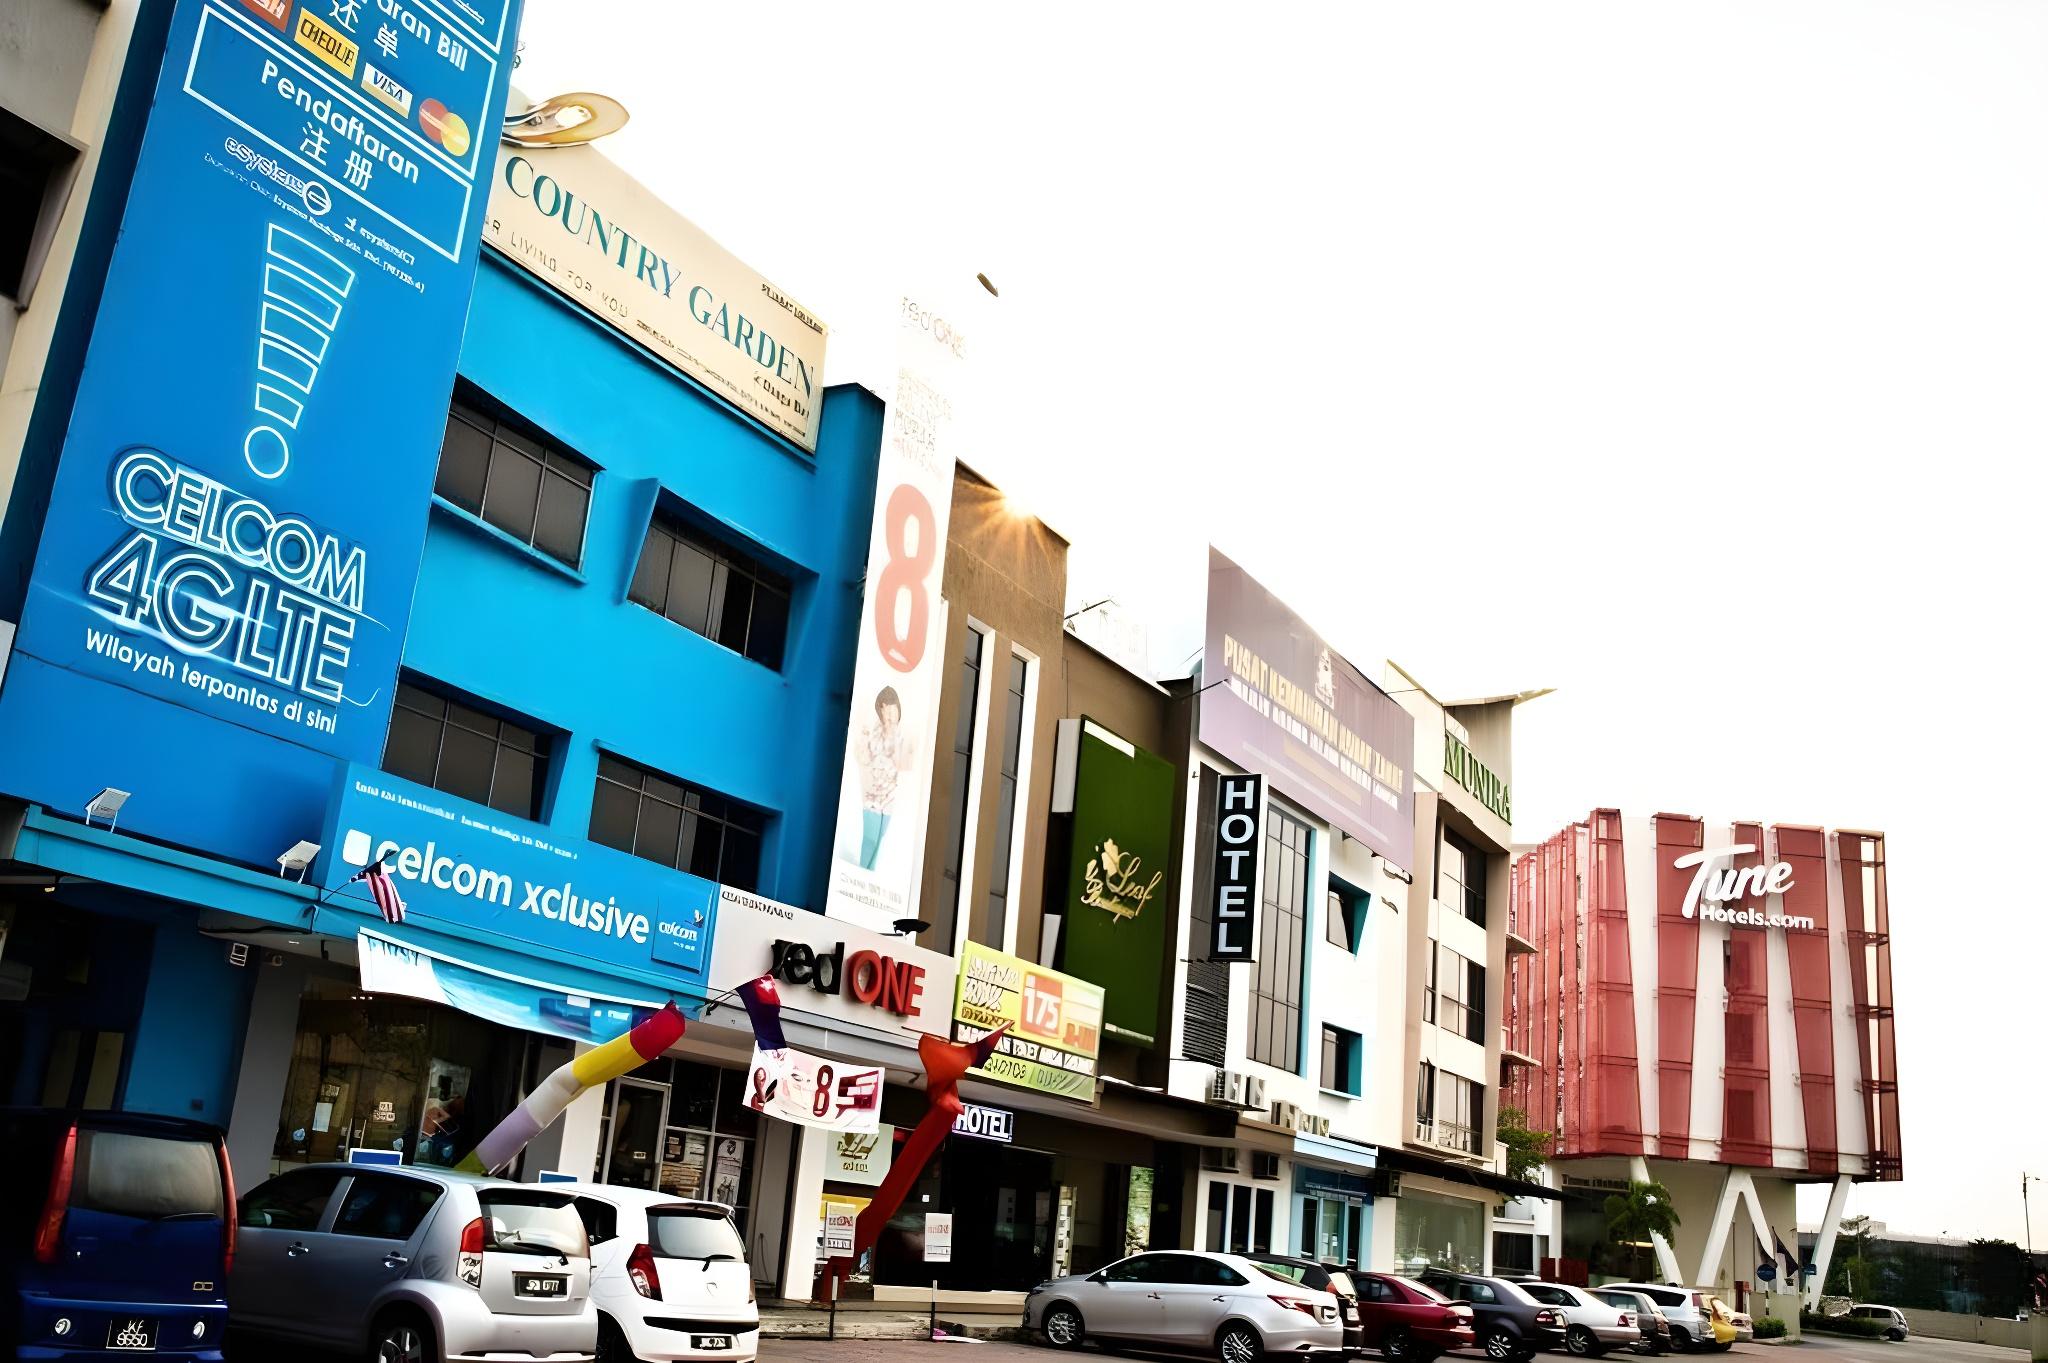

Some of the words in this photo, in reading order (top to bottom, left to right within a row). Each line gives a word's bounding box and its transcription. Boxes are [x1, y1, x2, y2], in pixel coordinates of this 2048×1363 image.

[362, 0, 430, 45] aran
[437, 31, 468, 72] Bill
[261, 59, 419, 184] Pendaftaran
[299, 122, 373, 191] 注册
[505, 156, 681, 299] COUNTRY
[689, 285, 815, 399] GARDEN
[115, 453, 366, 612] CELCOM
[875, 484, 936, 673] 8
[86, 628, 175, 680] Wilayah
[182, 662, 278, 714] terpantas
[283, 697, 302, 722] di
[306, 708, 337, 734] sini
[376, 840, 512, 907] celcom
[520, 880, 650, 944] xclusive
[1218, 780, 1255, 953] HOTEL
[1673, 843, 1795, 919] Tune
[1700, 903, 1815, 930] Hotels.com
[1023, 986, 1062, 1031] 175
[956, 1105, 1010, 1138] HOTEL
